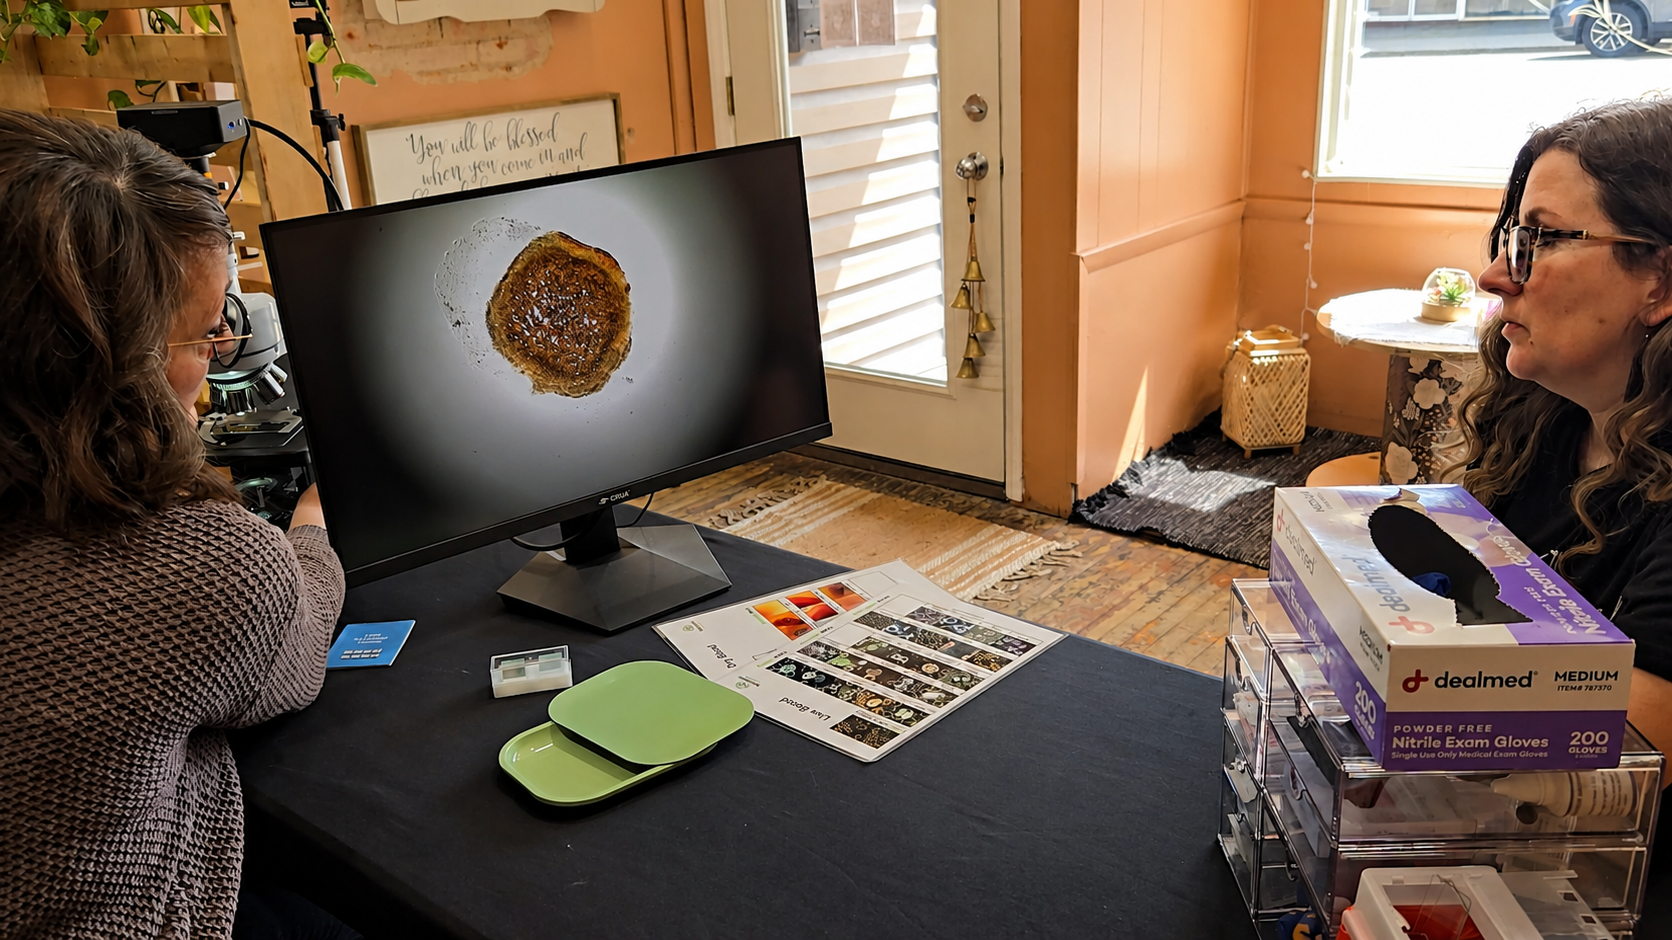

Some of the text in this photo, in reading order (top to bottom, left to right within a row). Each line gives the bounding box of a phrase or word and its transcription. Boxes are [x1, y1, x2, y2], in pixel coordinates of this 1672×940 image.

[406, 112, 560, 164] You will be blessed
[422, 155, 463, 186] when
[469, 158, 497, 183] you
[501, 158, 534, 176] come
[539, 148, 553, 165] in
[558, 132, 587, 164] and
[1525, 568, 1567, 597] Exam
[1434, 671, 1533, 688] dealmed
[1554, 671, 1619, 681] MEDIUM
[1354, 681, 1377, 724] 200
[1393, 724, 1493, 733] POWDER FREE
[1392, 735, 1549, 749] Nitrile Exam Gloves
[1569, 731, 1609, 746] 200
[1391, 751, 1418, 760] Single
[1437, 751, 1457, 760] Only
[1568, 746, 1608, 754] GLOVES
